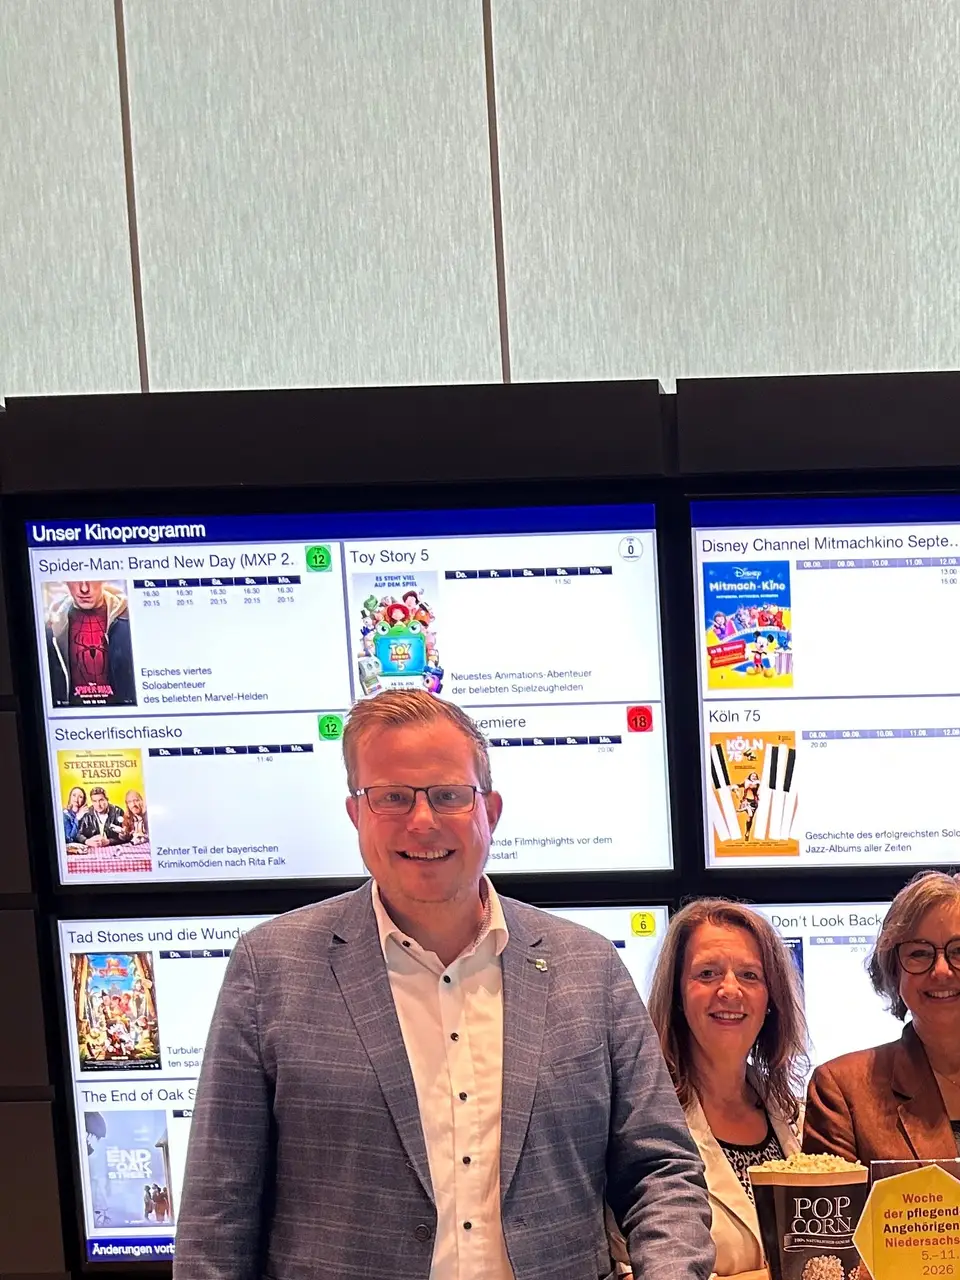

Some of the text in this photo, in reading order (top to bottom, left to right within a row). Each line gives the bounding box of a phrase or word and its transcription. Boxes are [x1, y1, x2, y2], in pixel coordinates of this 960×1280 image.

[32, 522, 206, 542] Unser Kinoprogramm
[627, 545, 634, 555] 0
[702, 539, 748, 555] Disney
[753, 536, 810, 552] Channel
[815, 535, 904, 550] Mitmachkino
[39, 553, 294, 574] Spider-Man: Brand New Day (MXP 2.
[313, 554, 325, 565] 12
[350, 549, 429, 566] Toy Story 5
[389, 643, 412, 655] TOY
[141, 666, 212, 679] Episches viertes
[451, 669, 592, 681] Neuestes Animations-Abenteuer
[142, 680, 206, 690] Soloabenteuer
[451, 682, 584, 695] der beliebten Spielzeughelden
[144, 691, 269, 704] des beliebten Marvel-Helden
[476, 716, 526, 729] remiere
[632, 715, 647, 728] 18
[709, 709, 761, 723] Köln 75
[55, 725, 183, 741] Steckerlfischfiasko
[325, 723, 338, 734] 12
[726, 736, 764, 751] KÖLN
[728, 751, 743, 763] 75
[64, 759, 137, 769] STECKERLFISCH
[82, 768, 121, 778] FIASKO
[515, 837, 574, 847] Filmhighlights
[593, 836, 613, 844] dem
[805, 830, 854, 841] Geschichte
[857, 830, 873, 840] des
[875, 829, 939, 841] erfolgreichsten
[157, 844, 279, 856] Zehnter Teil der bayerischen
[805, 843, 912, 854] Jazz-Albums aller Zeiten
[157, 856, 286, 869] Krimikomödien nach Rita Falk
[640, 920, 647, 929] 6
[771, 914, 882, 928] Don't Look Back
[67, 931, 93, 943] Tad
[97, 930, 144, 943] Stones
[148, 929, 173, 941] und
[177, 928, 197, 940] die
[82, 1090, 107, 1102] The
[111, 1089, 136, 1102] End
[141, 1089, 153, 1101] of
[158, 1088, 184, 1100] Oak
[106, 1149, 151, 1163] END
[902, 1193, 943, 1204] Woche
[793, 1196, 851, 1218] POP
[884, 1209, 904, 1219] der
[791, 1217, 852, 1234] CORN
[883, 1222, 960, 1235] Angehörigen
[92, 1243, 152, 1256] Änderungen
[923, 1264, 954, 1275] 2026
